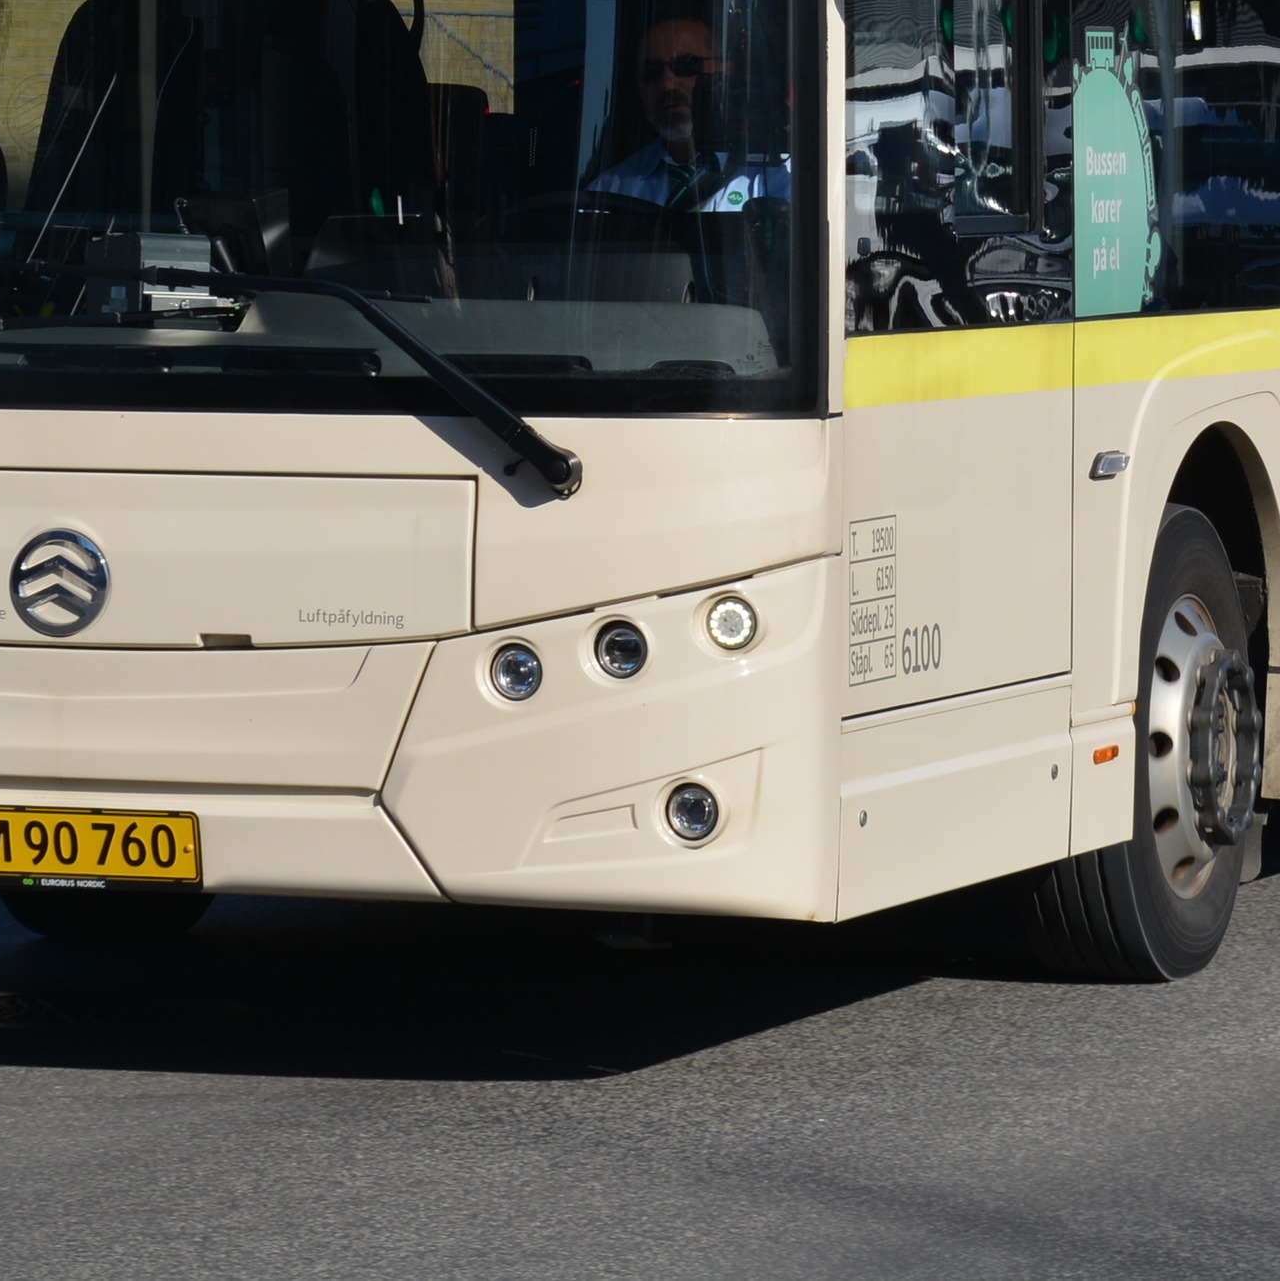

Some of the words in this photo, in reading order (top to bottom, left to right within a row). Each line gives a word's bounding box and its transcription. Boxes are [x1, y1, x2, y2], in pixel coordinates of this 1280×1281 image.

[1086, 146, 1127, 176] Bussen
[1091, 192, 1122, 223] kører
[1093, 238, 1108, 279] på
[1109, 239, 1121, 270] el
[851, 531, 859, 557] T.
[872, 526, 894, 553] 19500
[851, 571, 859, 596] L.
[876, 565, 894, 591] 6150
[298, 608, 405, 630] Luftpåfyldning
[851, 605, 882, 639] Siddepl.
[884, 605, 894, 630] 25
[884, 644, 895, 669] 65
[902, 623, 942, 675] 6100
[23, 820, 79, 866] 90
[91, 822, 177, 868] 760
[41, 879, 75, 887] EUROBUS
[76, 880, 106, 889] NORDIC
